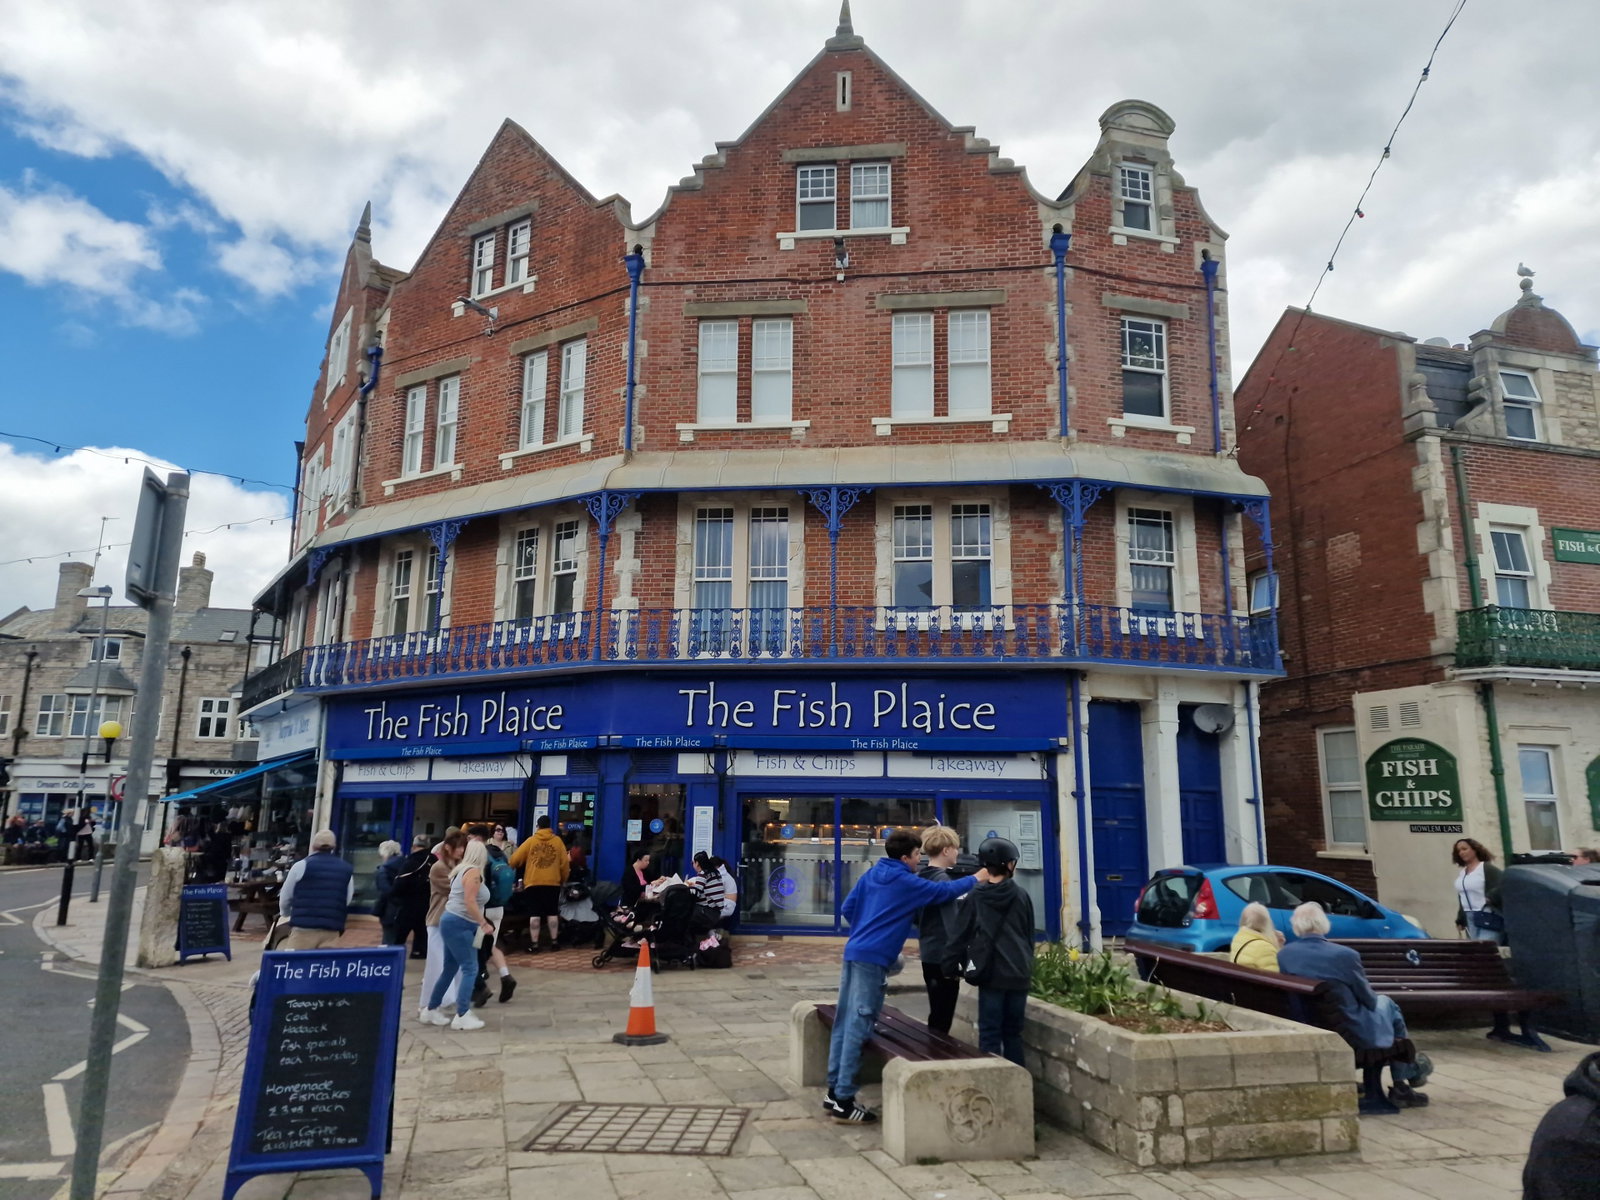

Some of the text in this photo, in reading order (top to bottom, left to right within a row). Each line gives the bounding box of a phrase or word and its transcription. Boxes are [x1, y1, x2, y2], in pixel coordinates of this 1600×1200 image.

[1558, 540, 1585, 552] FISH
[678, 681, 996, 733] The Fish Plaice
[364, 691, 563, 740] The Fish Plaice
[540, 738, 588, 750] The Fish Plaice
[636, 737, 701, 748] The Fish Plaice
[851, 739, 919, 749] The Fish Plaice
[401, 746, 442, 756] The Fish Plaice
[357, 763, 415, 779] Fish & Chips
[457, 759, 507, 774] Takeaway
[756, 755, 856, 774] Fish & Chips
[929, 756, 1007, 777] Takeaway
[1381, 759, 1439, 778] FISH
[36, 780, 60, 789] Dream
[63, 780, 96, 790] Cottges
[1406, 779, 1416, 789] &
[1375, 790, 1453, 808] CHIPS
[1411, 825, 1461, 833] MOWLEM LANE
[274, 960, 391, 979] The Fish Plaice
[285, 1012, 309, 1021] Cod
[282, 1024, 328, 1034] Haddock
[305, 1036, 346, 1053] specials
[280, 1051, 358, 1065] each Thursday
[265, 1080, 333, 1094] Homemade
[289, 1091, 351, 1102] Fishcakes
[311, 1103, 344, 1112] each
[257, 1127, 282, 1140] Tea
[299, 1126, 338, 1137] Coffee
